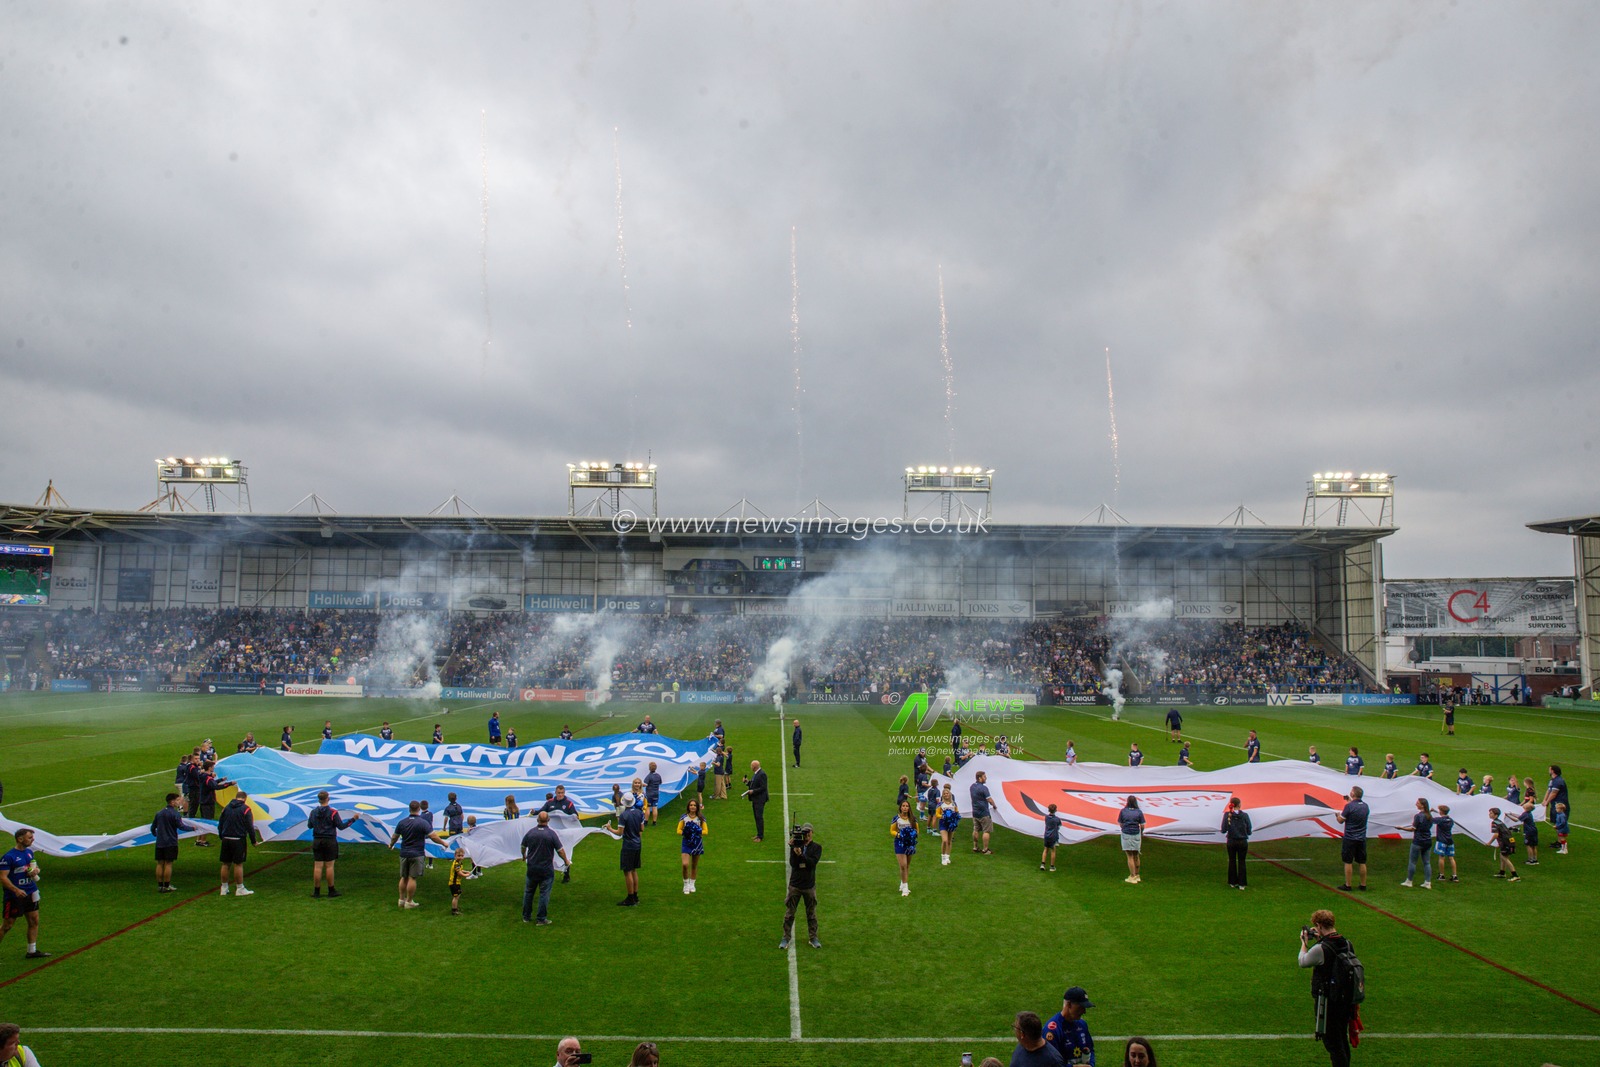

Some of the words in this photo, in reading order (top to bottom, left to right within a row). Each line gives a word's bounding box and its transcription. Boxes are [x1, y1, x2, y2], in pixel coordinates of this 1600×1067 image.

[314, 593, 370, 606] Halliwell
[385, 595, 423, 607] Jones
[530, 597, 588, 610] Halliwell
[602, 598, 640, 610] Jones
[896, 603, 956, 612] HALLIWELL
[968, 603, 999, 614] JONES
[1181, 605, 1211, 615] JONES
[1484, 615, 1515, 623] Projects
[285, 686, 323, 696] Guardian
[457, 690, 492, 698] Halliwell
[814, 694, 849, 702] PRIMAS
[851, 694, 870, 702] LAW
[389, 760, 641, 780] WOLVES
